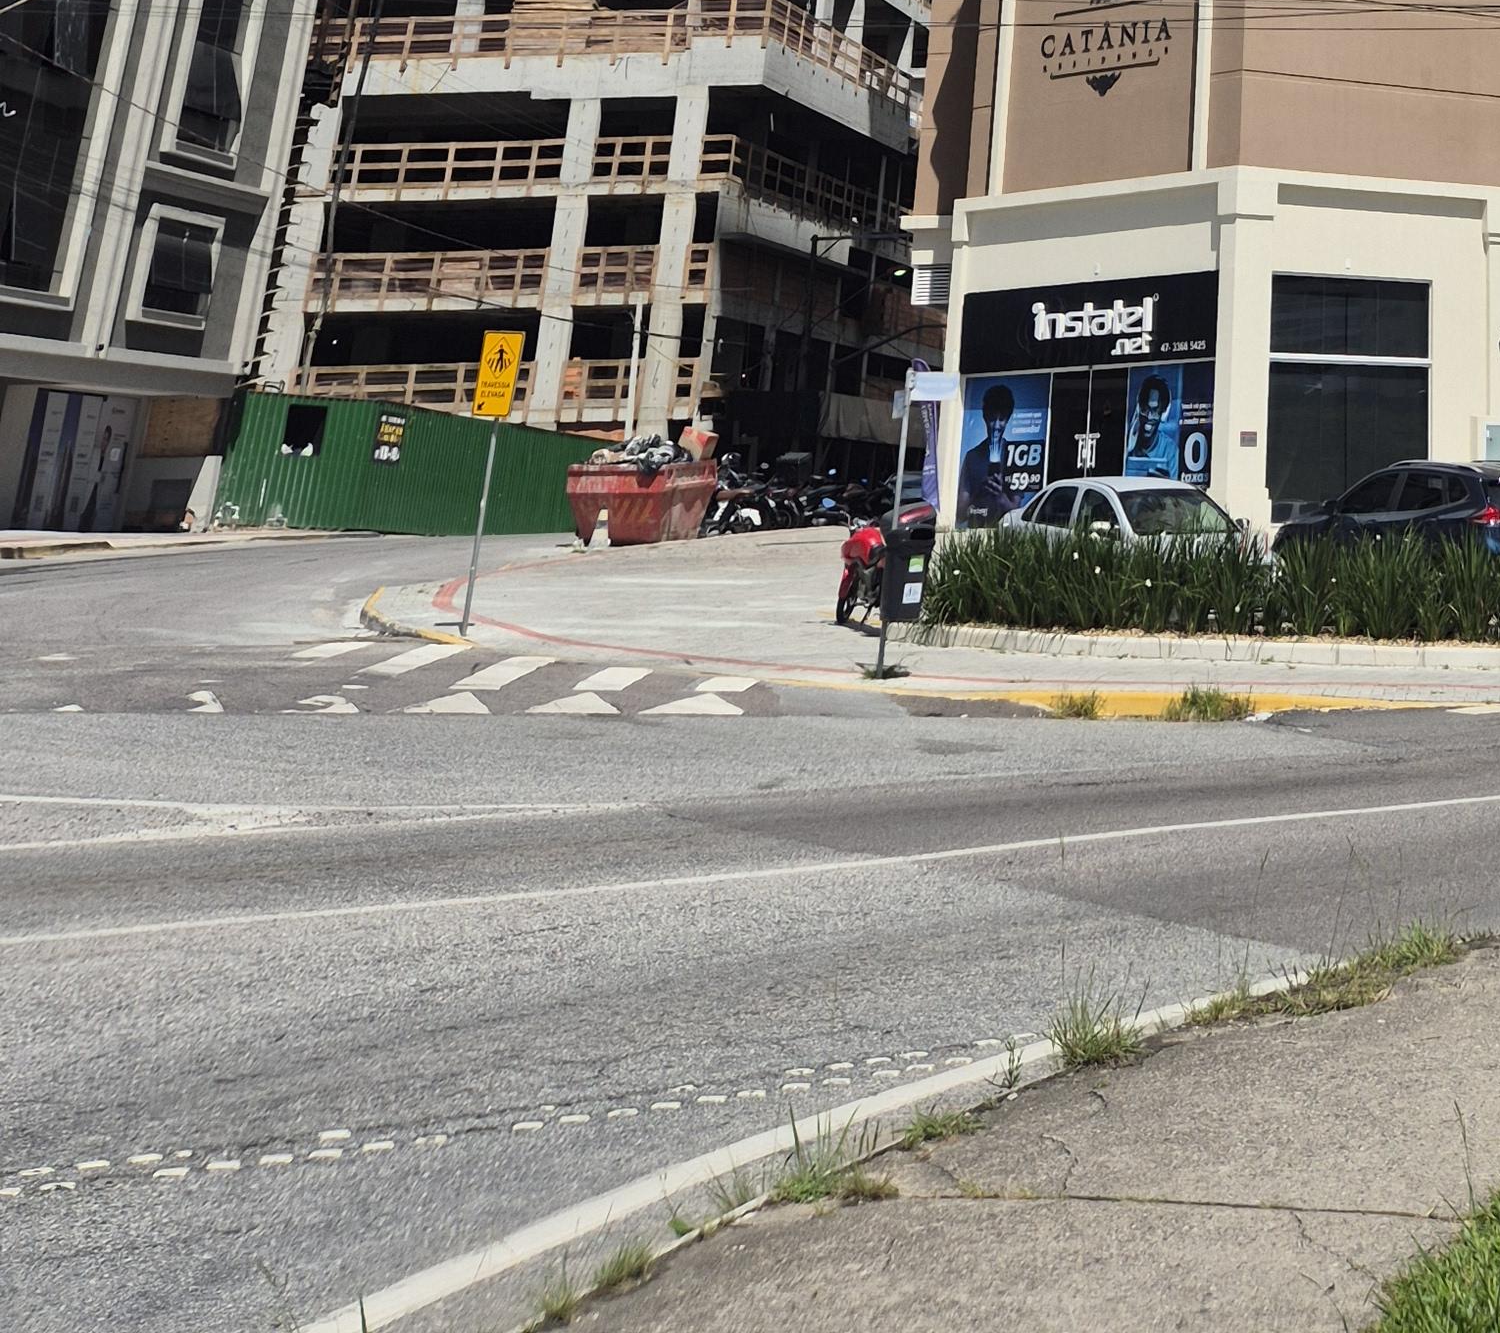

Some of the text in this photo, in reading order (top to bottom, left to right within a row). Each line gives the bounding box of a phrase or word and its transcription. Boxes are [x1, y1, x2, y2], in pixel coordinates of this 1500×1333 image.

[1041, 17, 1172, 59] CATÂNIA
[1031, 296, 1153, 342] instatel
[1006, 443, 1042, 467] 1GB
[1184, 431, 1209, 472] 0
